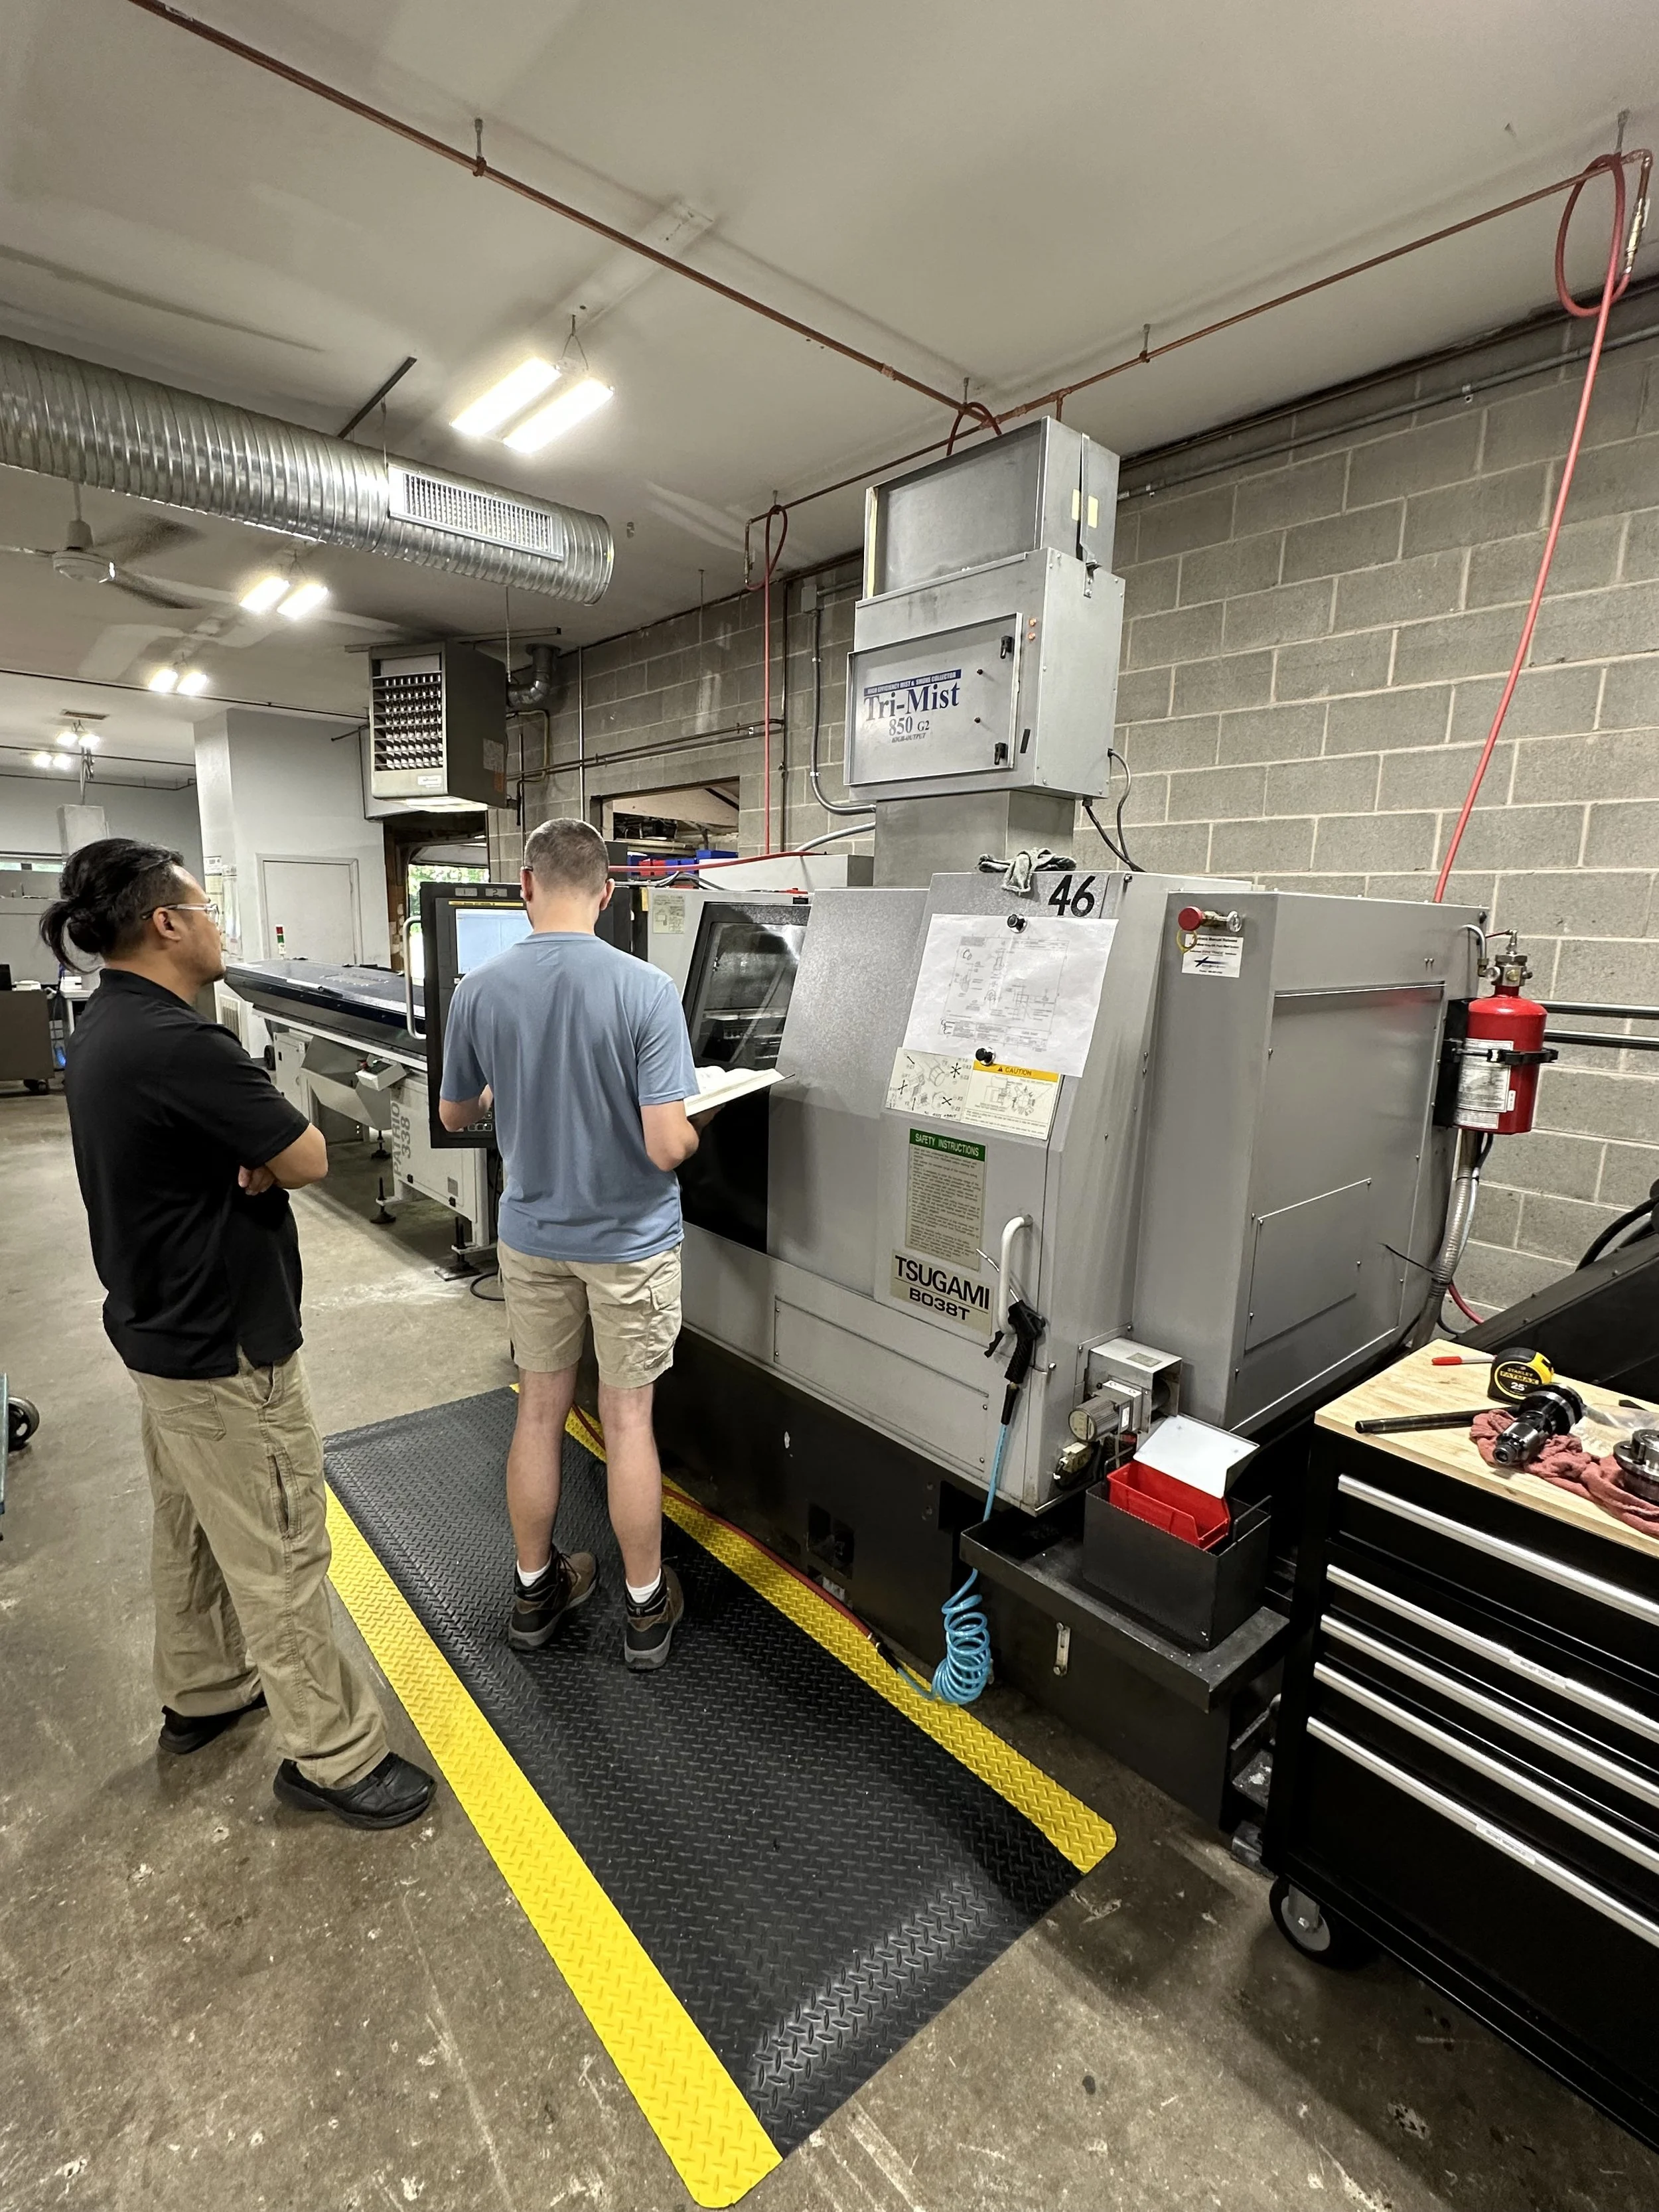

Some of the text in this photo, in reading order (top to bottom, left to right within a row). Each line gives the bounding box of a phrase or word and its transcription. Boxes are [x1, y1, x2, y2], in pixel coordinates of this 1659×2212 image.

[863, 682, 960, 721] Tri-Mist
[889, 716, 930, 736] 850 G2
[1048, 874, 1096, 917] 46
[1005, 1066, 1032, 1076] CAUTION
[401, 1116, 411, 1159] 338
[915, 1133, 979, 1157] SAFETY INSTRUCTIONS
[895, 1254, 989, 1310] TSUGAMI
[1500, 1371, 1538, 1384] FATMAX
[1507, 1367, 1533, 1377] STANLEY
